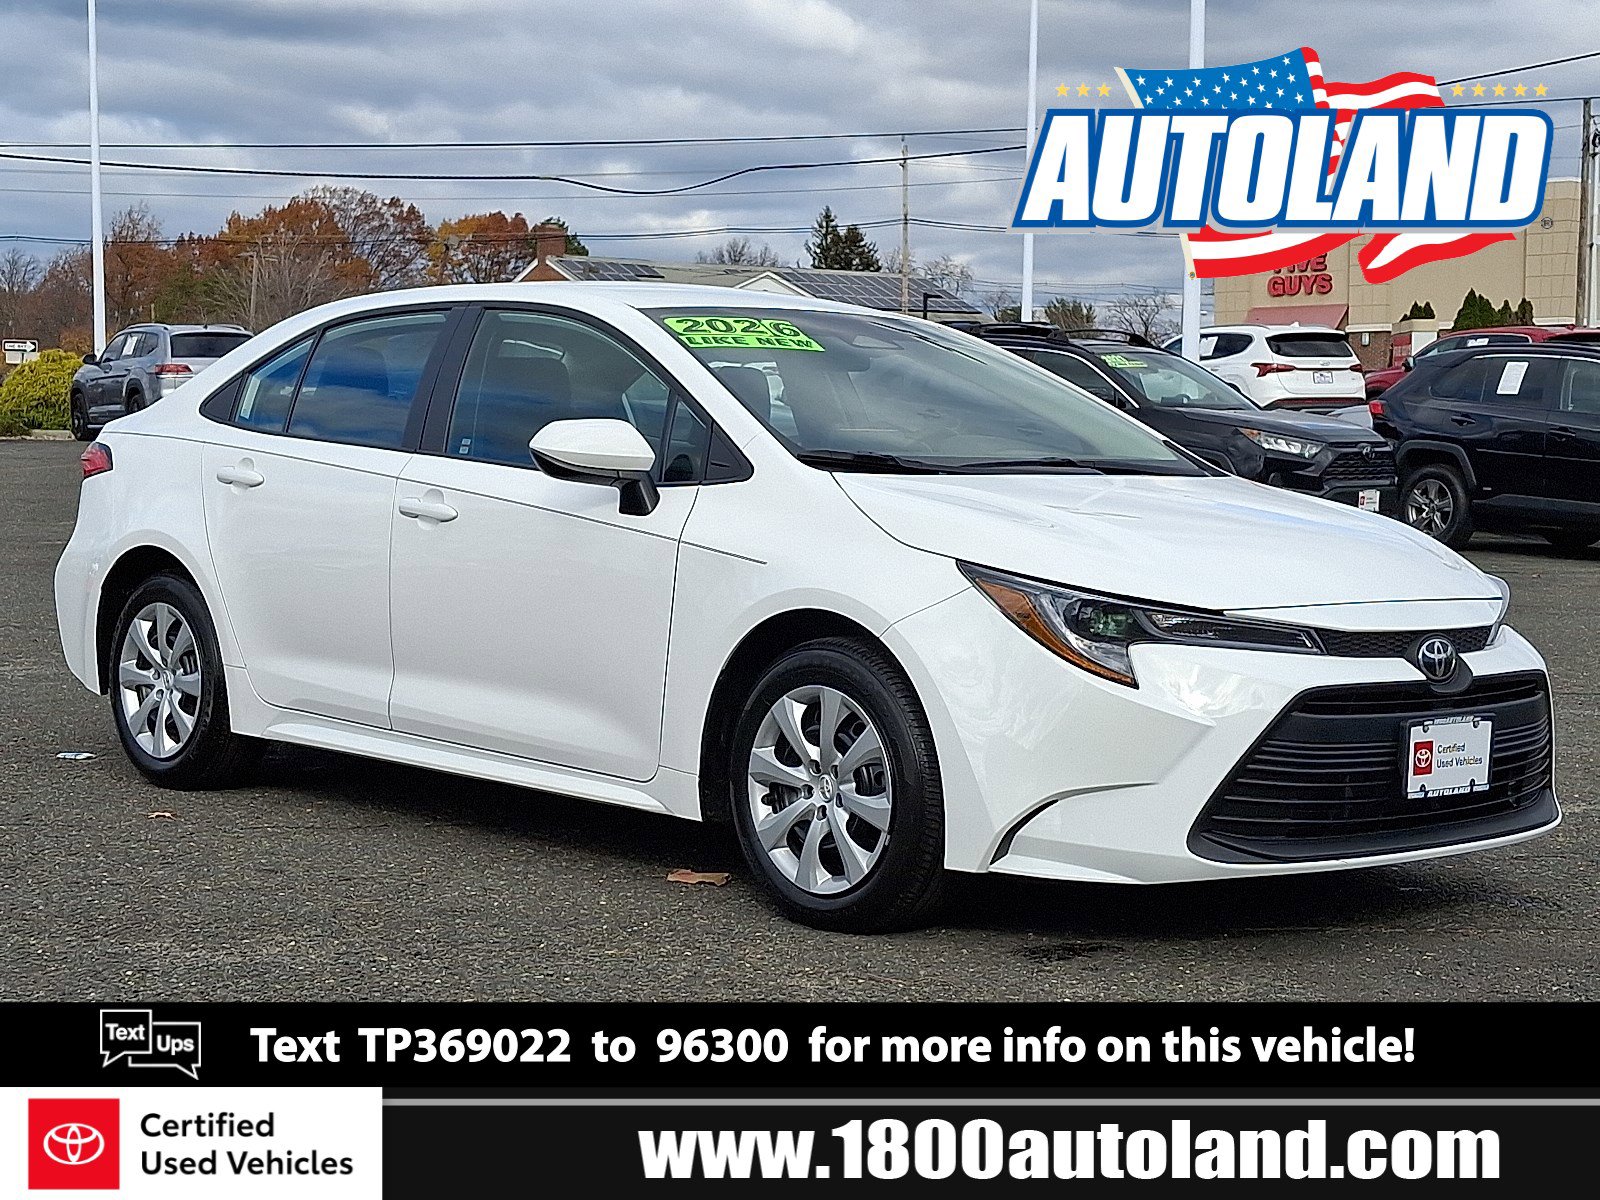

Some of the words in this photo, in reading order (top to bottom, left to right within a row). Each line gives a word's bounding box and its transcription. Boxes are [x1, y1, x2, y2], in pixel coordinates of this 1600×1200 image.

[1268, 274, 1332, 296] GUYS
[676, 318, 801, 338] 2026
[686, 336, 750, 346] LIKE
[756, 337, 813, 349] NEW
[1437, 743, 1466, 754] Certified
[1436, 758, 1454, 768] Used
[1455, 755, 1483, 767] Vehicles
[1427, 786, 1471, 798] AUTOLAND
